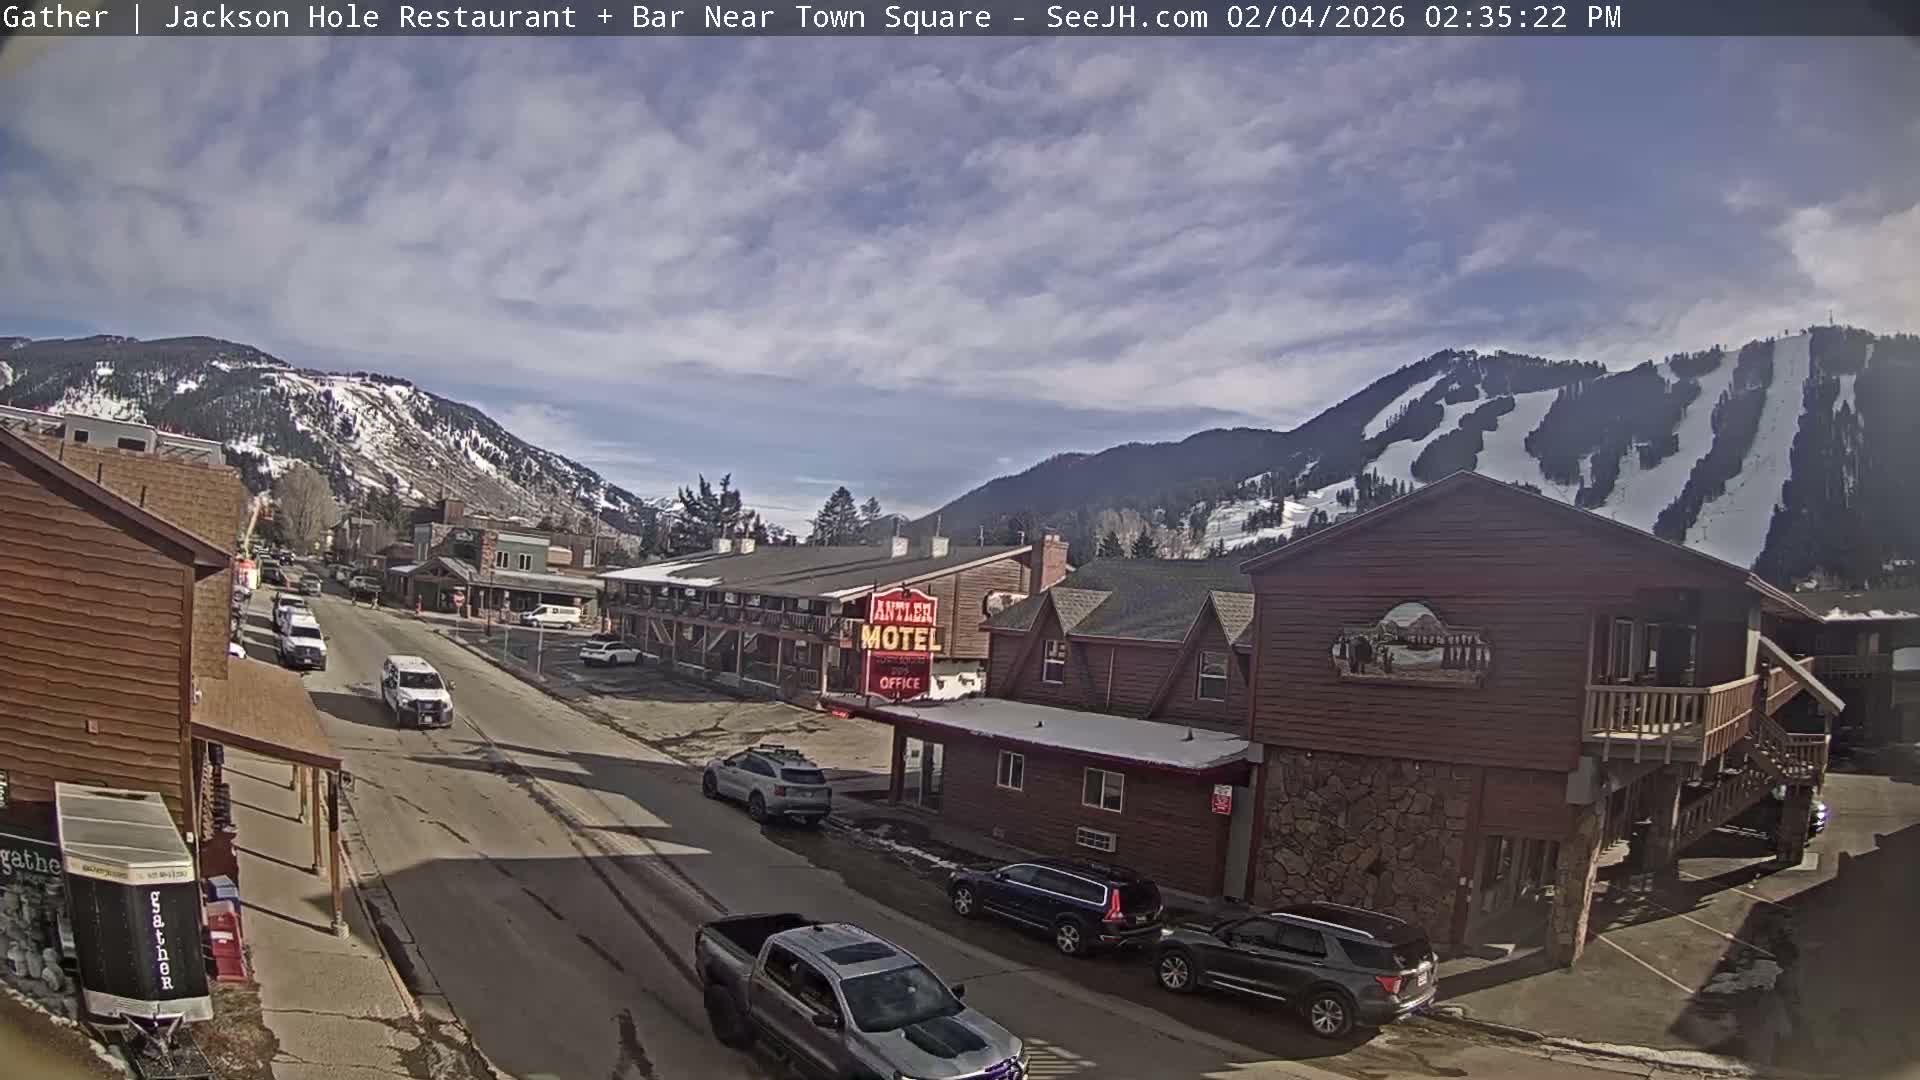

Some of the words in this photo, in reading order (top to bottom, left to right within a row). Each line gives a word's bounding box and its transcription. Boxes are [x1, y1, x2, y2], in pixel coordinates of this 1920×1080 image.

[874, 600, 933, 623] ANTLER
[861, 624, 942, 651] MOTEL
[880, 676, 920, 689] OFFICE
[0, 849, 61, 876] gathe
